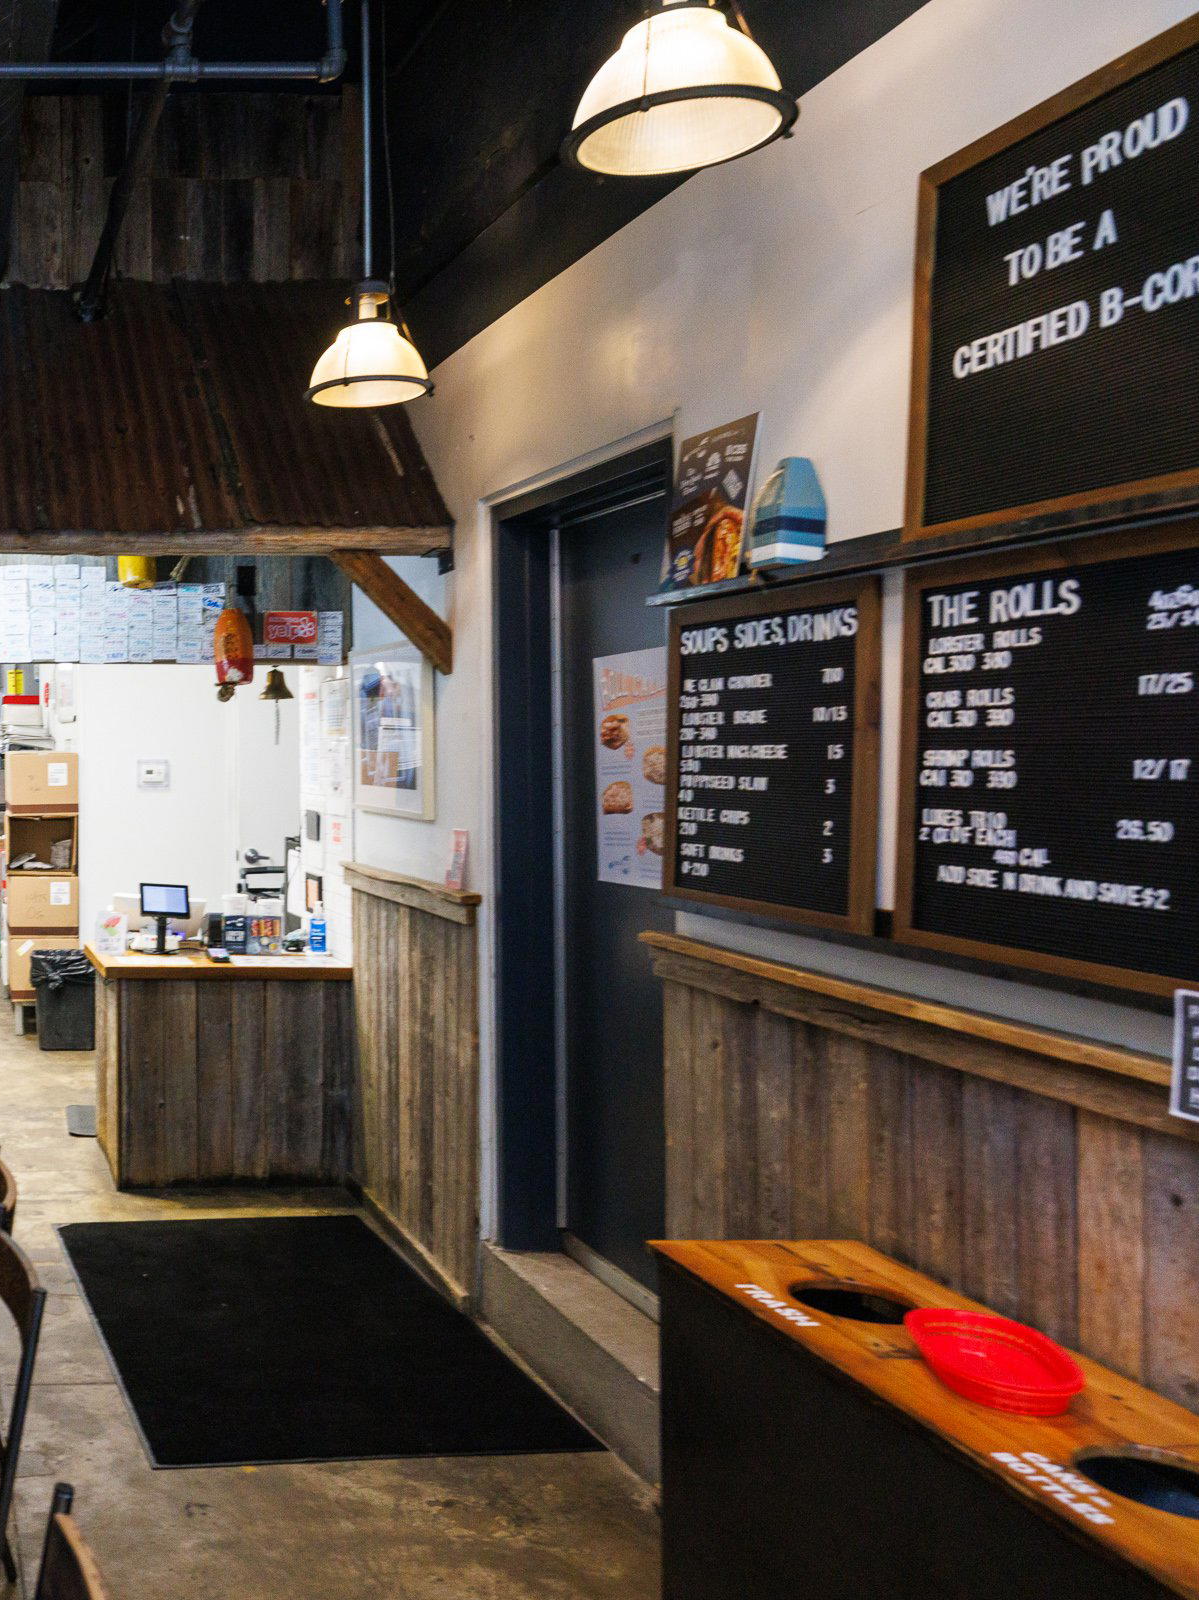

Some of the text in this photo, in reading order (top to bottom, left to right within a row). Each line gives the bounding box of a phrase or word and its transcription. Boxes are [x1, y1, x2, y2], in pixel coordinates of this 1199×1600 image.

[986, 97, 1190, 227] WE'RE PROUD
[1004, 208, 1118, 286] TO BE A
[953, 300, 1090, 378] CERTIFIED
[927, 579, 1081, 628] THE ROLLS
[681, 627, 729, 655] SOUPS
[787, 608, 858, 643] DRINKS
[929, 627, 1042, 655] LOBSTER ROLLS
[966, 688, 1015, 707] ROLLS
[971, 749, 1015, 768] ROLLS
[824, 778, 837, 795] 3
[822, 820, 834, 836] 2
[822, 848, 834, 865] 3
[734, 1283, 821, 1327] TRASH
[990, 1451, 1116, 1524] BOTTLES
[1021, 1451, 1099, 1494] CANS
